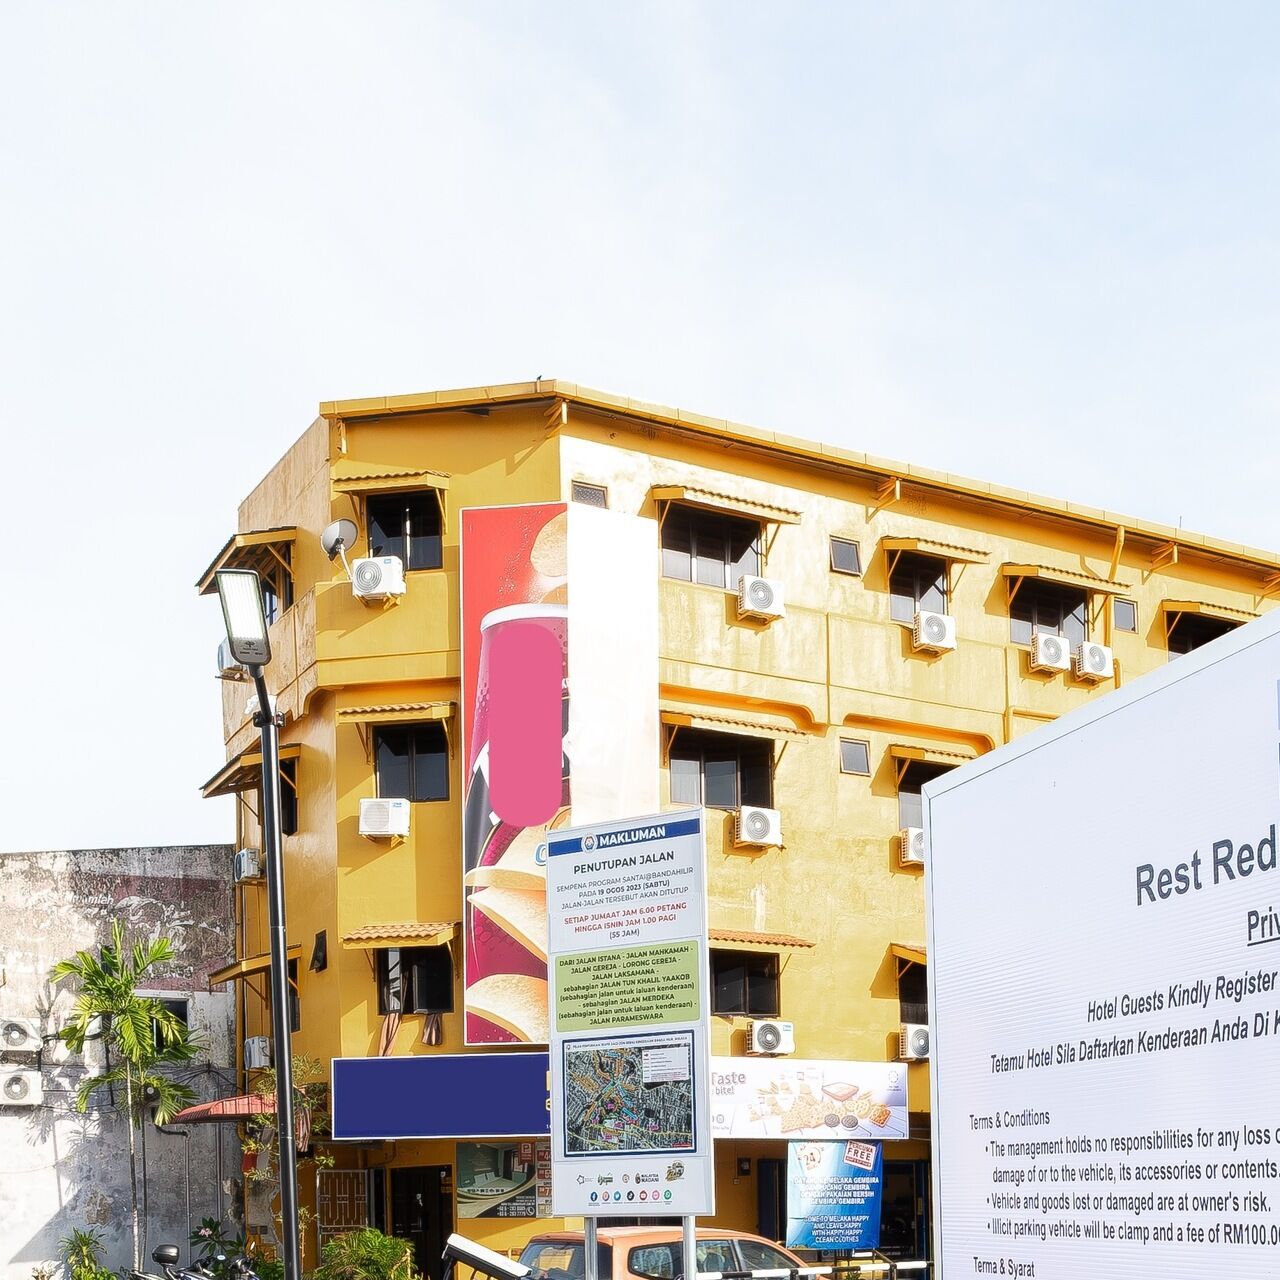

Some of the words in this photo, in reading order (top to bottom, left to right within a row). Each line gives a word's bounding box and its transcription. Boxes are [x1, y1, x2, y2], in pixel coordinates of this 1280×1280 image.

[599, 826, 665, 847] MAKLUMAN
[574, 857, 636, 873] PENUTUPAN
[639, 851, 673, 864] JALAN
[556, 882, 586, 892] SEMPENA
[588, 877, 621, 887] PROGRAM
[642, 879, 669, 890] (SABTU)
[1136, 849, 1202, 906] Rest
[561, 898, 603, 909] JALAN-JALAN
[605, 893, 637, 902] TERSEBUT
[639, 890, 657, 898] AKAN
[659, 886, 688, 895] DITUTUP
[564, 915, 588, 924] SETIAP
[590, 911, 620, 920] JUMAAT
[656, 902, 686, 911] PETANG
[574, 924, 602, 932] HINGGA
[625, 918, 640, 926] JAM
[622, 928, 639, 936] JAM)
[576, 956, 596, 964] JALAN
[649, 946, 688, 955] MAHKAMAH
[622, 959, 649, 968] LORONG
[651, 956, 676, 964] GEREJA
[614, 968, 654, 977] LAKSAMANA
[563, 983, 598, 991] sebahagian
[600, 980, 620, 988] JALAN
[662, 973, 689, 981] YAAKOB
[560, 992, 597, 1002] (sebahagian
[598, 990, 613, 998] jalan
[657, 982, 694, 990] kenderaan)
[582, 999, 618, 1007] sebahagian
[619, 996, 640, 1004] JALAN
[642, 993, 674, 1001] MERDEKA
[1087, 995, 1117, 1022] Hotel
[1120, 989, 1164, 1016] Guests
[1167, 979, 1211, 1008] Kindly
[1214, 969, 1278, 1002] Register
[558, 1010, 595, 1019] (sebahagian
[596, 1008, 612, 1016] jalan
[655, 1000, 692, 1009] kenderaan)
[612, 1013, 663, 1022] PARAMESWARA
[990, 1054, 1024, 1073] Tetamu
[1026, 1045, 1053, 1068] Hotel
[1055, 1042, 1075, 1064] Sila
[1078, 1035, 1133, 1061] Daftarkan
[1137, 1026, 1207, 1053] Kenderaan
[1210, 1015, 1248, 1043] Anda
[1252, 1010, 1269, 1037] Di
[969, 1114, 993, 1130] Terms
[995, 1111, 1001, 1128] &
[1003, 1108, 1050, 1127] Conditions
[989, 1140, 1005, 1156] The
[1007, 1137, 1063, 1159] management
[1065, 1135, 1092, 1153] holds
[1094, 1137, 1107, 1152] no
[1110, 1128, 1193, 1155] responsibilities
[1196, 1127, 1214, 1147] for
[1217, 1130, 1239, 1151] any
[1243, 1124, 1270, 1145] loss
[847, 1148, 871, 1161] FREE
